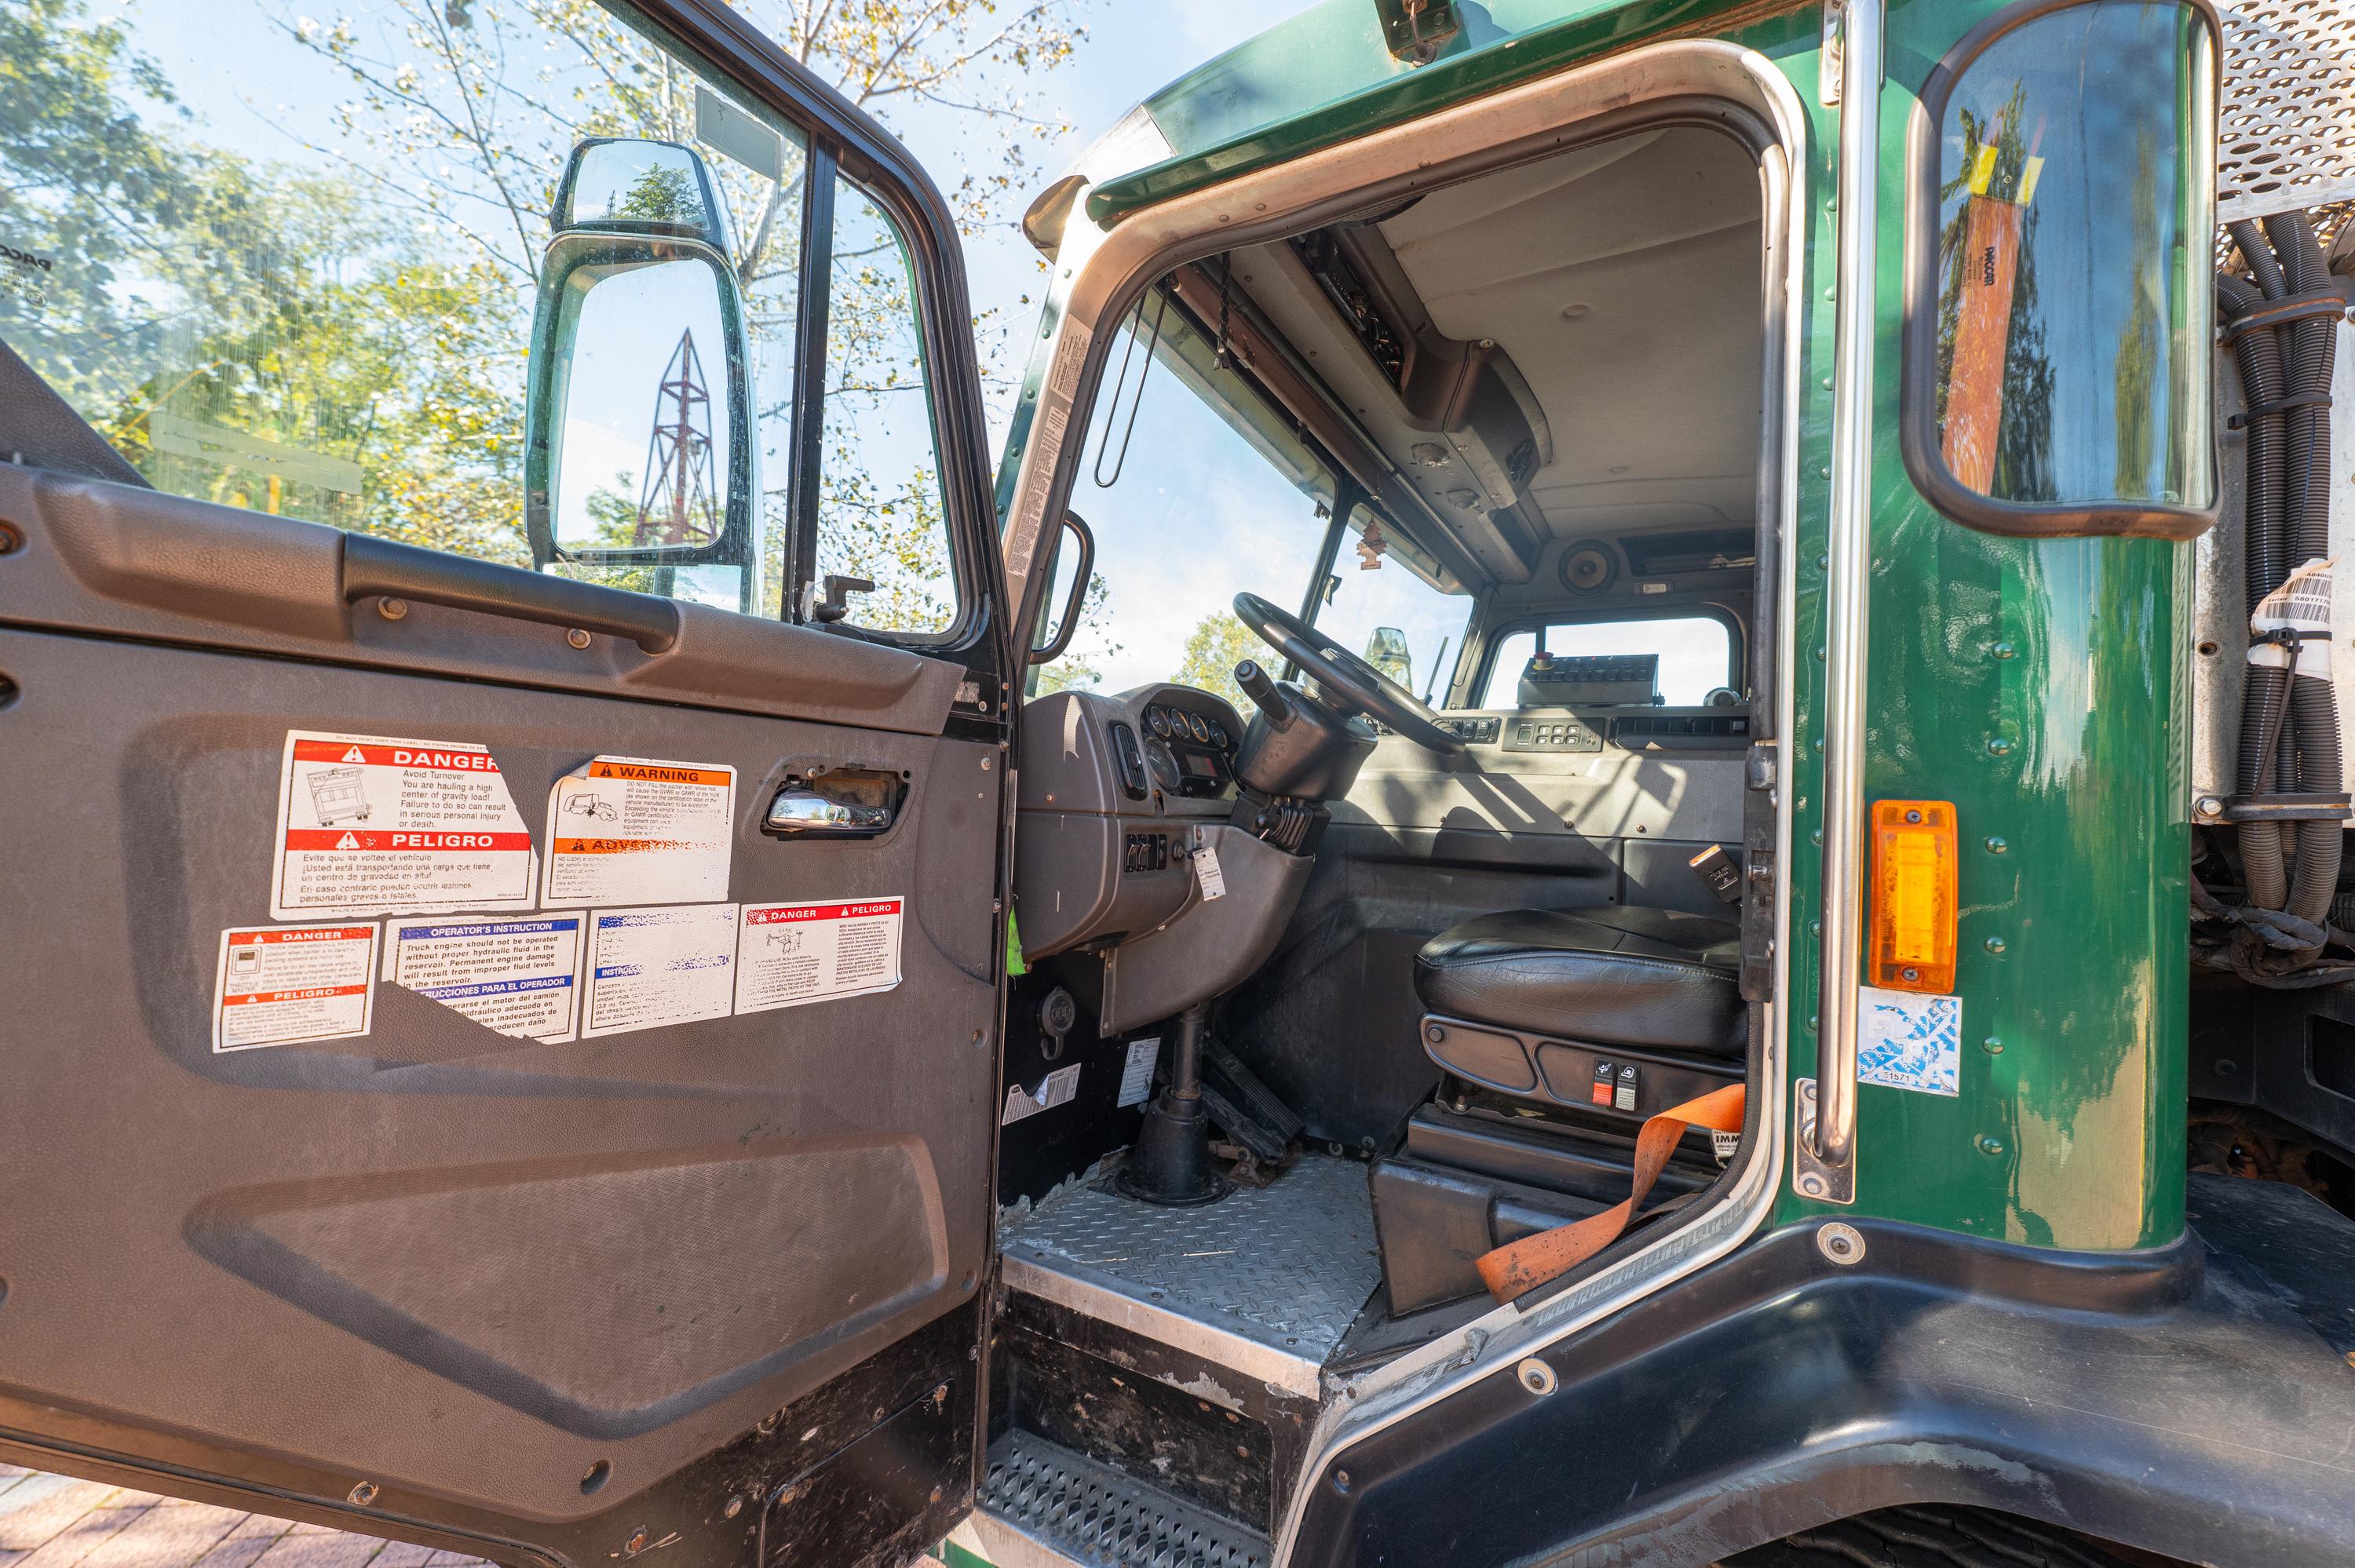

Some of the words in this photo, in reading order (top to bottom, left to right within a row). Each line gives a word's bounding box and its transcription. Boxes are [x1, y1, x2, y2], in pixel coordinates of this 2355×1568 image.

[1984, 246, 1995, 286] PACCAR
[430, 771, 465, 780] Turnover
[620, 767, 699, 782] WARNING
[437, 782, 466, 792] hauling
[476, 784, 493, 793] high
[442, 792, 468, 800] gravity
[471, 793, 490, 801] load!
[444, 812, 477, 822] personal
[392, 834, 493, 847] PELIGRO
[771, 910, 816, 920] DANGER
[853, 905, 892, 914] PELIGRO
[431, 926, 491, 936] OPERATOR'S
[494, 923, 552, 933] INSTRUCTION
[283, 932, 341, 941] DANGER
[525, 935, 558, 946] operated
[406, 952, 437, 961] without
[441, 951, 469, 960] proper
[473, 947, 509, 957] hydraulic
[404, 961, 446, 970] reservoir.
[450, 957, 494, 967] Permanent
[497, 955, 523, 965] engine
[526, 953, 555, 961] damage
[433, 977, 472, 986] reservoir.
[482, 984, 506, 993] PARA
[520, 978, 565, 990] OPERADOR
[274, 989, 334, 1000] PELIGRO
[533, 990, 559, 1000] camión
[505, 1003, 541, 1012] adecuado
[498, 1011, 545, 1021] inadecuados
[1862, 1053, 1876, 1067] VOID
